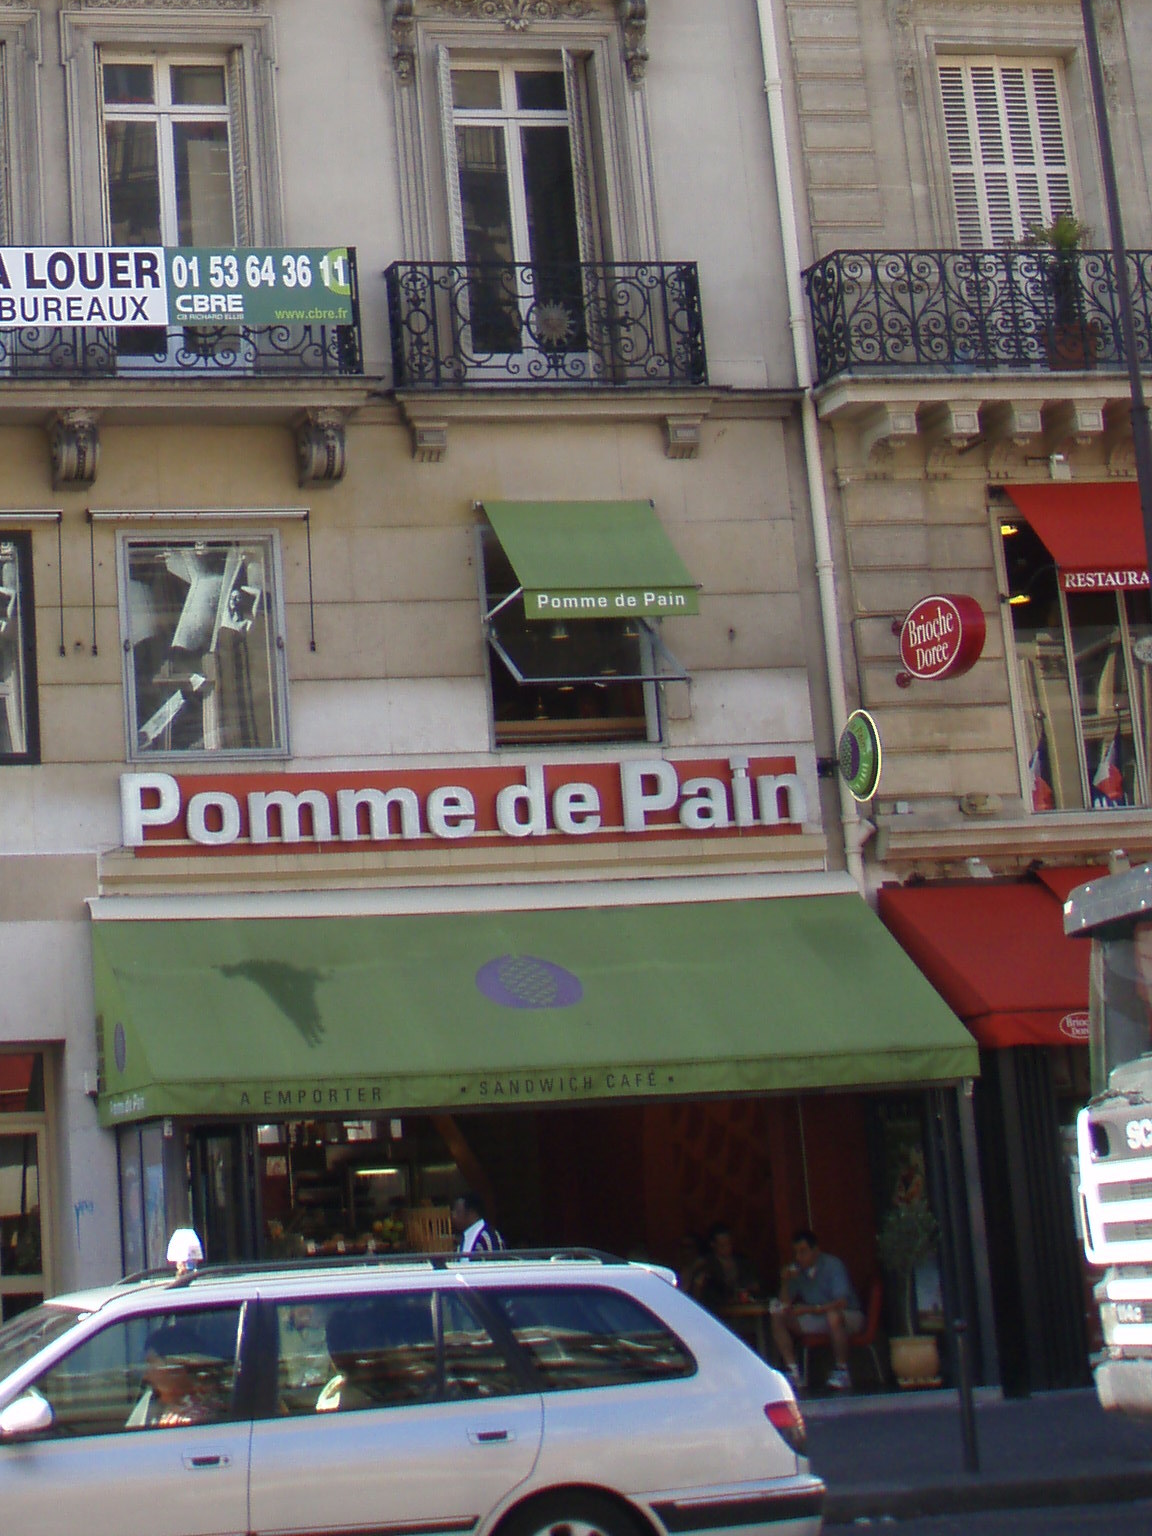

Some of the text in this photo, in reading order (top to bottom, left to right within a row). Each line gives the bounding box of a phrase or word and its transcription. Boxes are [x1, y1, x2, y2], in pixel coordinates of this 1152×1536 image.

[24, 251, 161, 290] LOUER
[172, 255, 345, 288] 01 53 64 36 11
[175, 294, 244, 313] CBRE
[274, 306, 347, 320] www.cbre.fr
[537, 592, 685, 608] Pomme de Pain
[908, 606, 953, 648] Brioche
[120, 757, 808, 846] Pomme de Pain
[241, 1087, 382, 1105] A EMPORTER
[479, 1069, 657, 1096] SANDWICH CAFÉ
